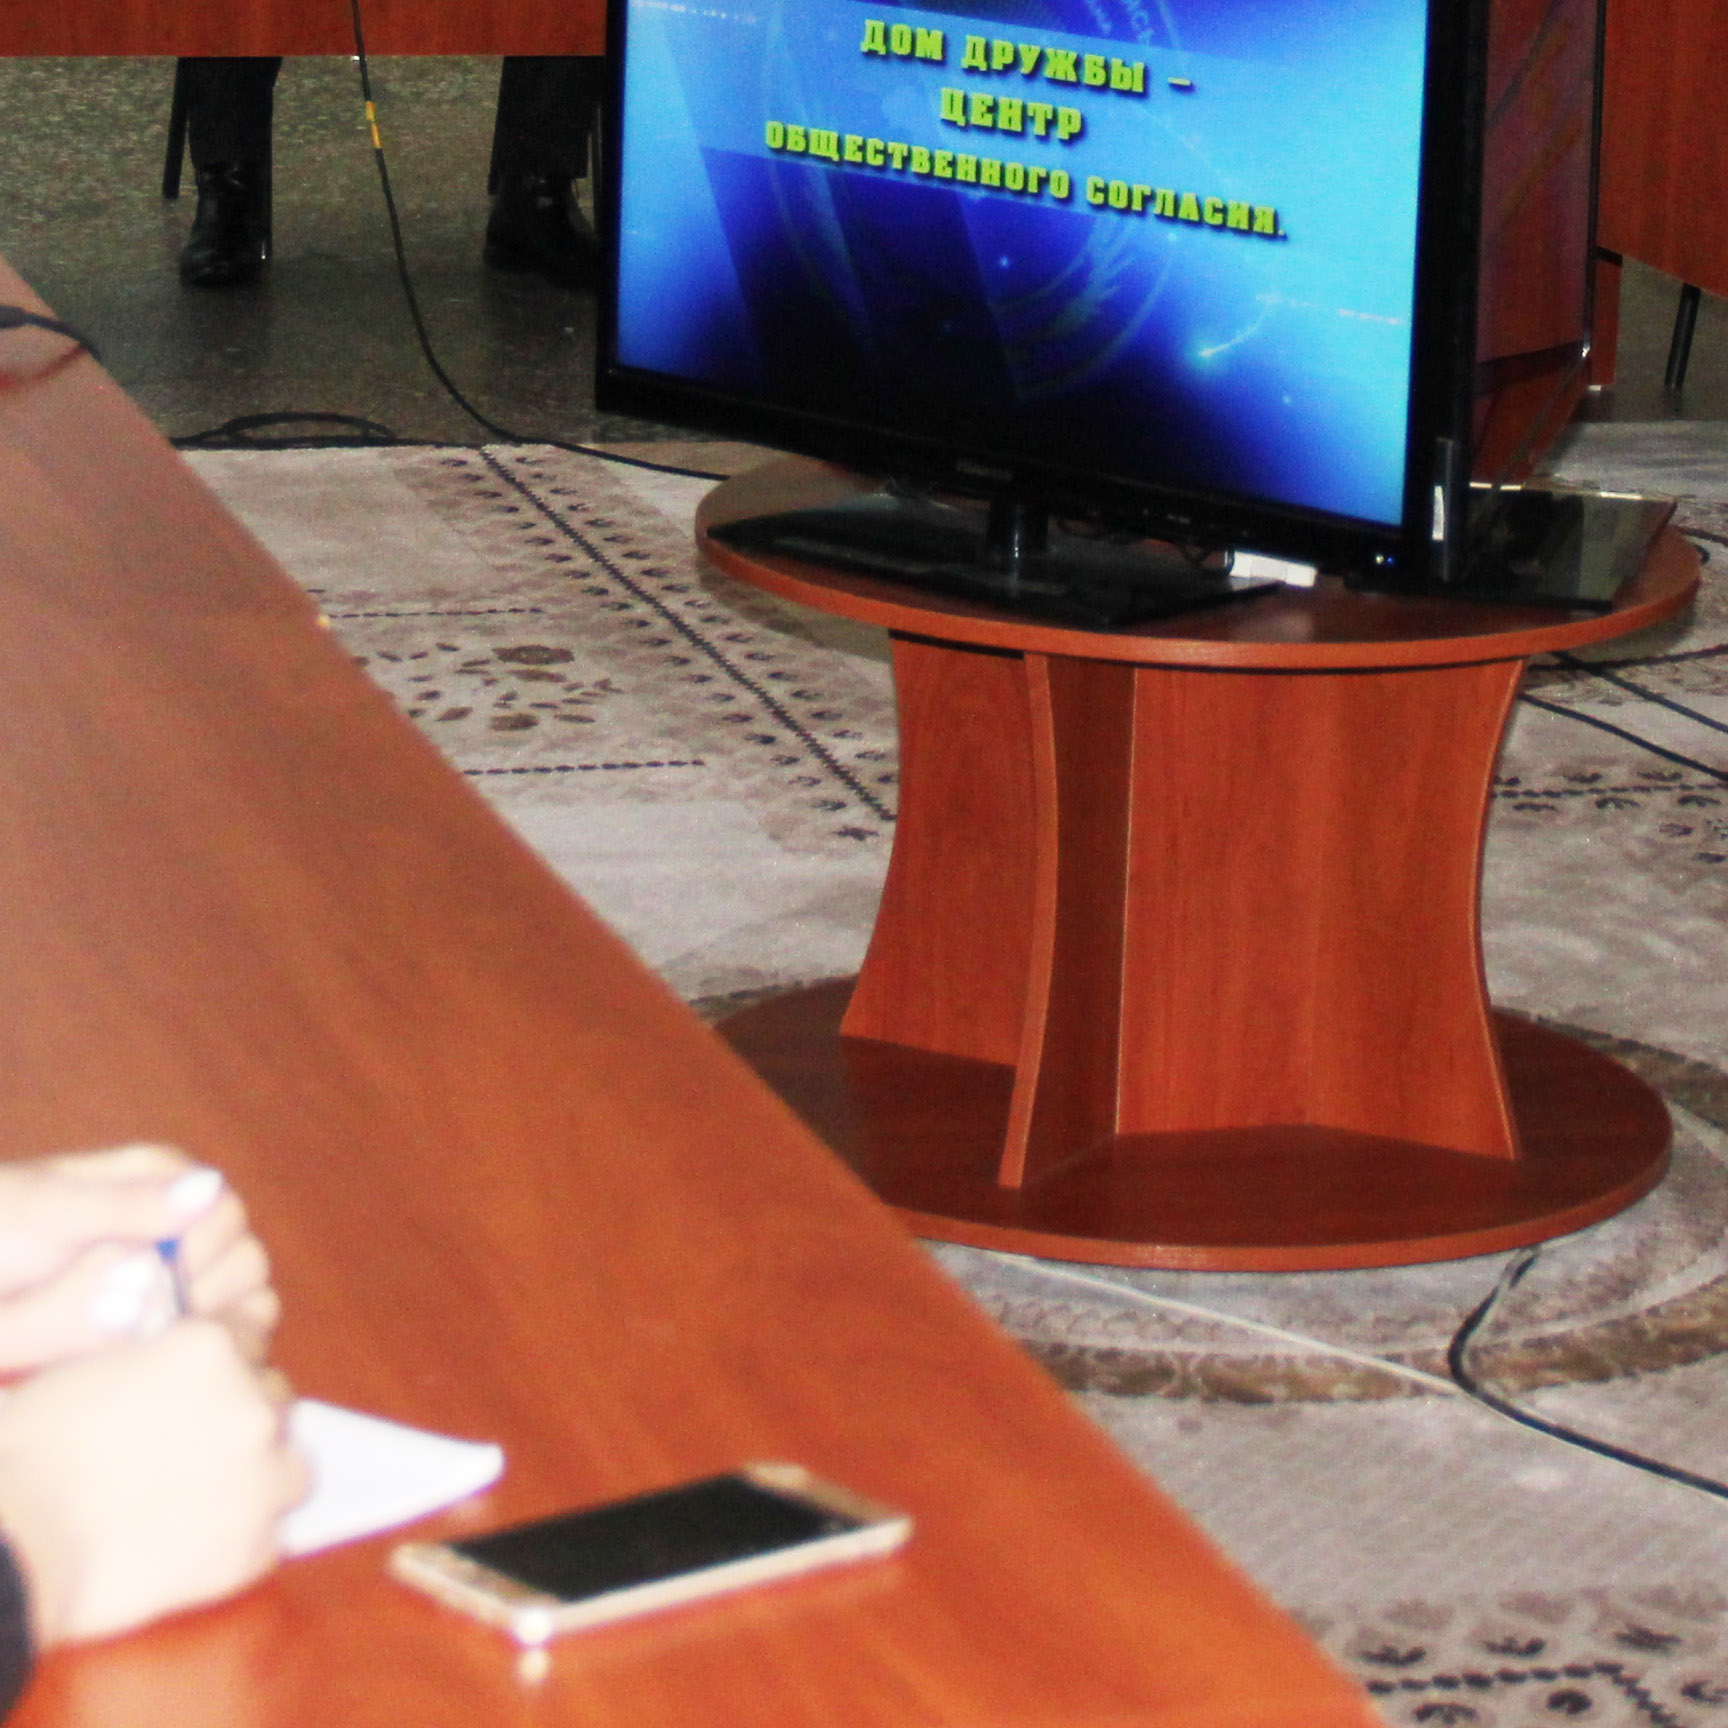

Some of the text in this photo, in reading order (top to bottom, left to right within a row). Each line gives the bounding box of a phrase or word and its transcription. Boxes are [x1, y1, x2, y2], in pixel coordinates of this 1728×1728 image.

[860, 19, 945, 62] ДОМ
[961, 35, 1146, 94] ДРУЖБЫ
[939, 87, 1083, 141] ЦЕНТР
[764, 120, 1287, 237] ОБЩЕСТВЕННОГО СОГЛАСИЯ.
